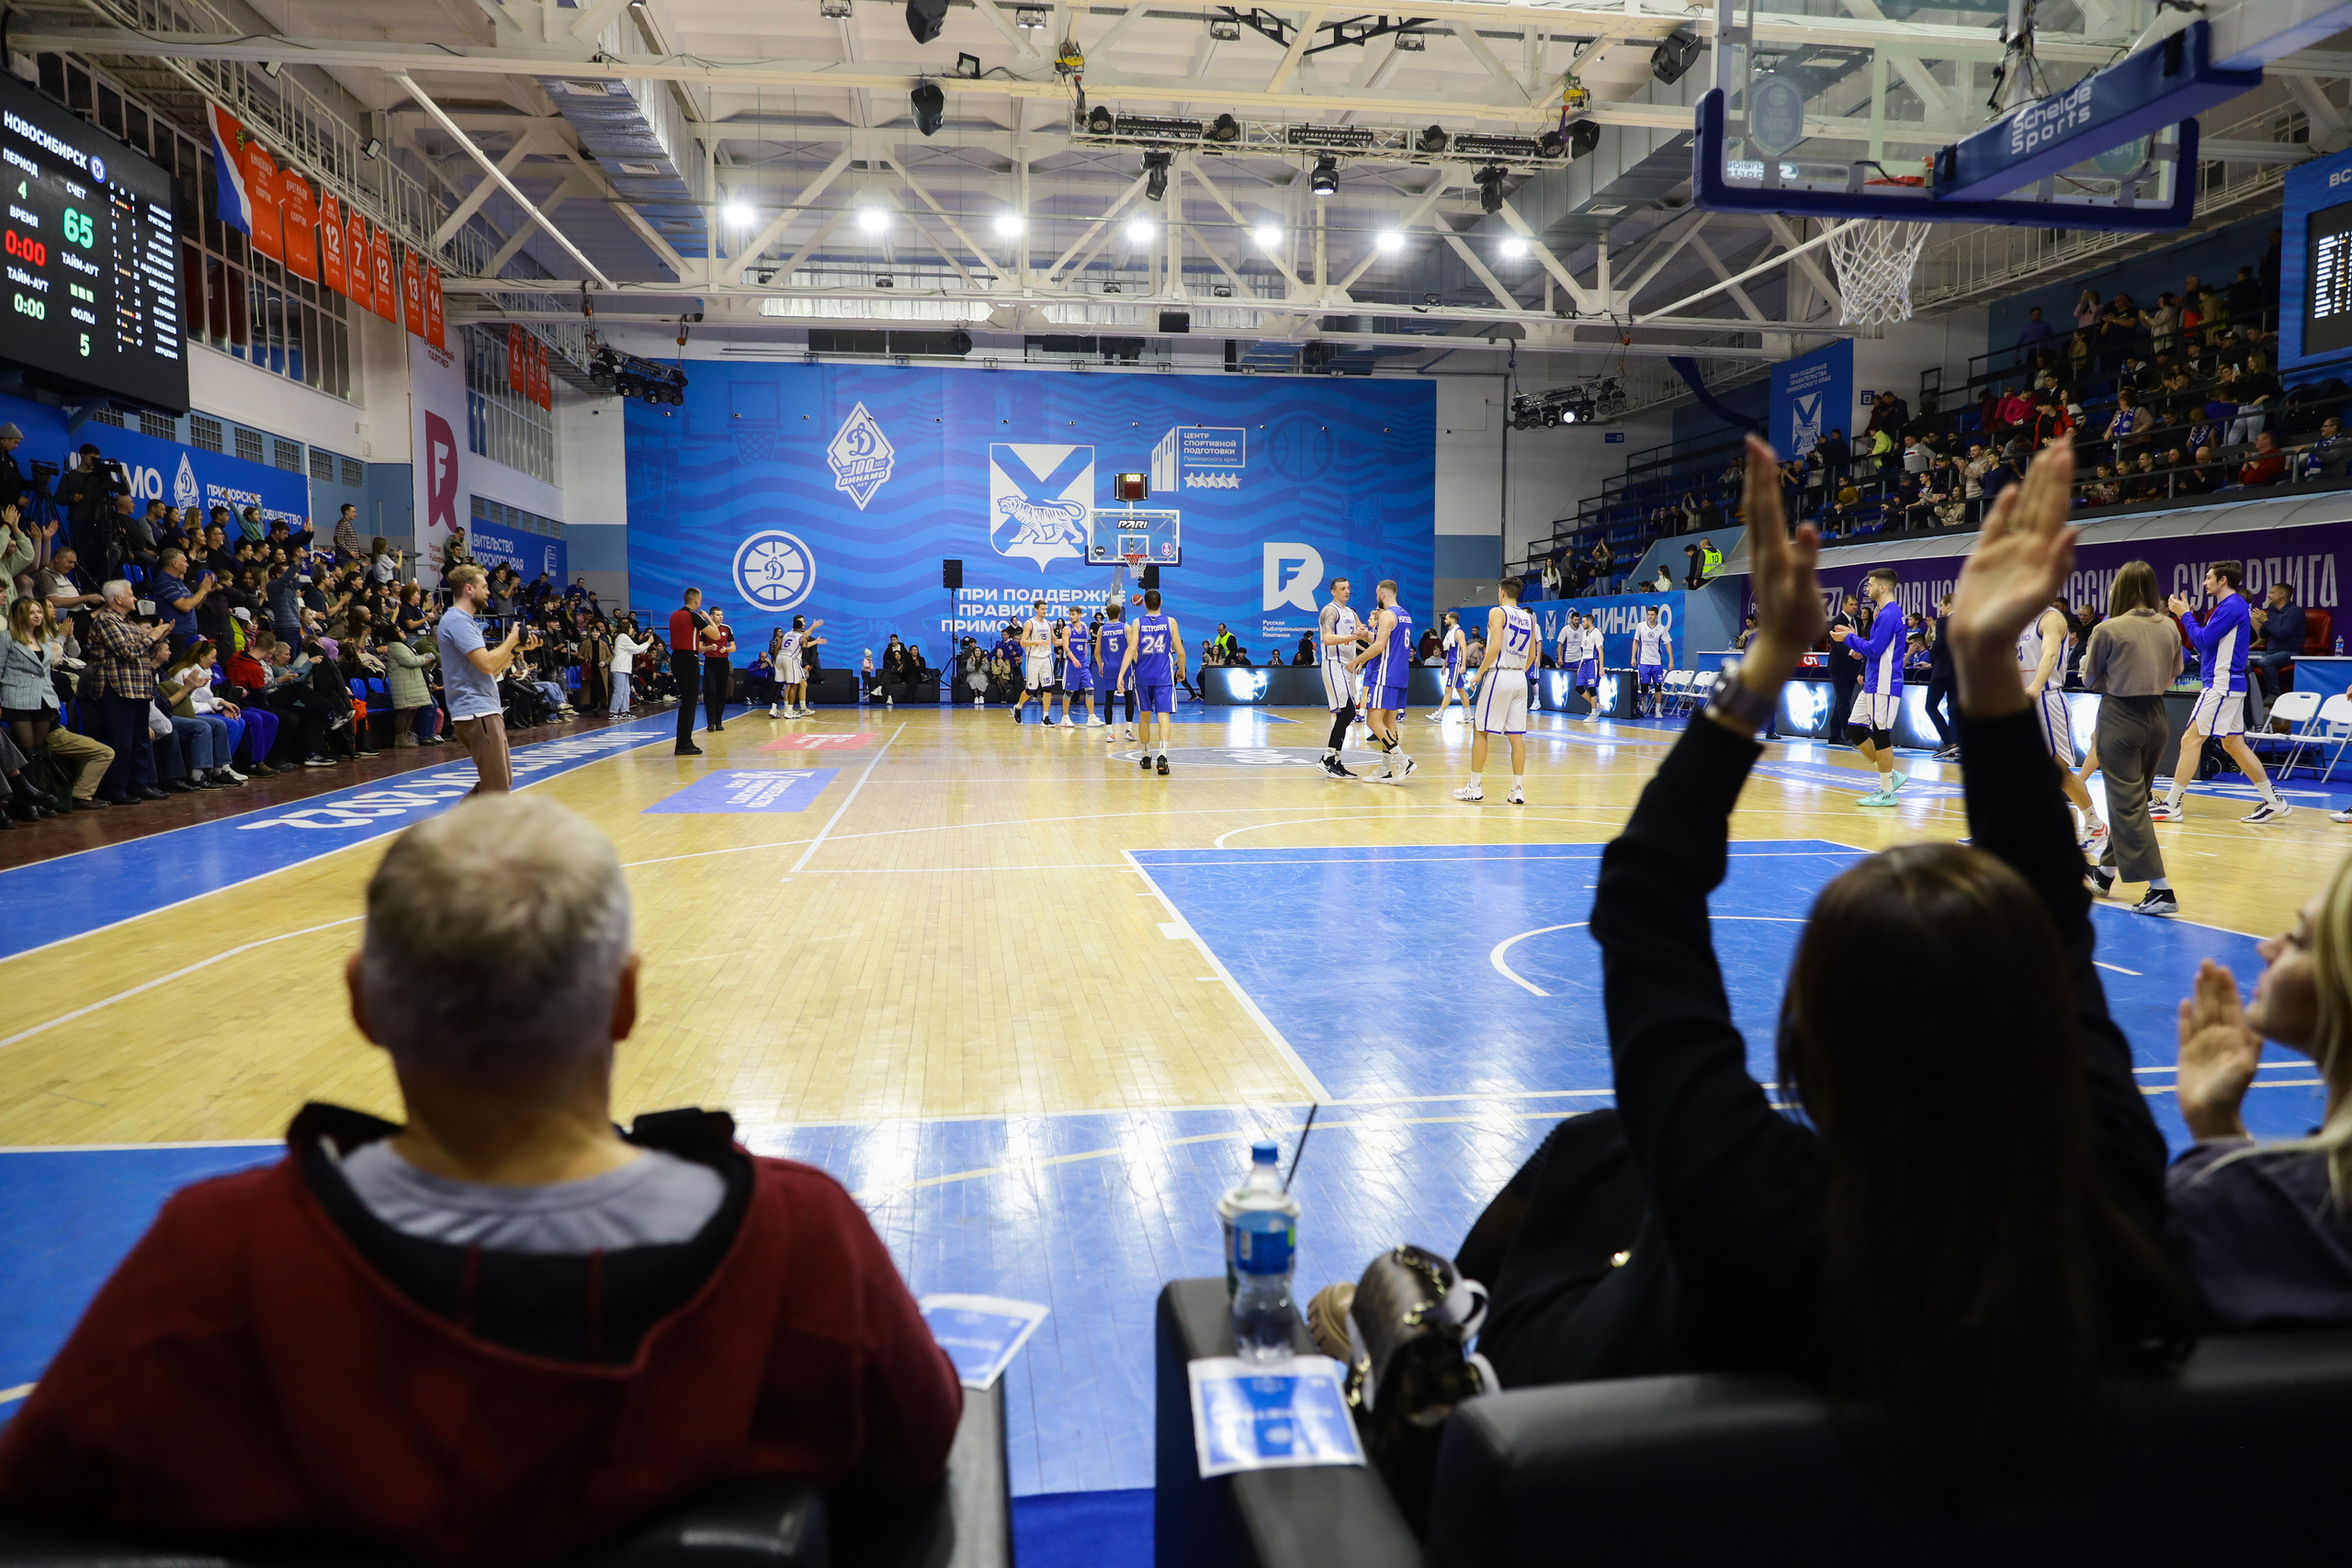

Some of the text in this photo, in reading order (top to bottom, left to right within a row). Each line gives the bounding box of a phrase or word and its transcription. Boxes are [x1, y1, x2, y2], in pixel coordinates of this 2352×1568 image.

[2012, 86, 2091, 136] Schelde
[4, 110, 87, 170] НОВОСИБИРСК
[2011, 106, 2091, 155] Sports
[3, 147, 39, 177] ПЕРИОД
[17, 181, 27, 199] 4
[66, 181, 86, 199] СЧЕТ
[9, 204, 39, 228] ВРЕМЯ
[63, 208, 94, 249] 65
[6, 230, 46, 266] 0:00
[324, 222, 340, 254] 12
[62, 251, 99, 277] ТАЙМ-АУТ
[354, 240, 363, 266] 7
[6, 265, 49, 292] ТАЙМ-АУТ
[376, 256, 390, 285] 12
[408, 277, 419, 301] 13
[429, 289, 440, 315] 14
[14, 292, 45, 321] 0:00
[71, 307, 96, 325] ФОЛЫ
[80, 333, 90, 356] 5
[514, 344, 519, 363] 6
[840, 471, 886, 486] ДИНАМО
[1117, 520, 1148, 529] PARI
[1712, 555, 1719, 563] 10
[959, 589, 993, 601] ПРИ
[2173, 553, 2338, 612] СУРЛИГА
[784, 638, 793, 648] 6
[1109, 637, 1119, 652] 5
[1141, 634, 1166, 655] 24
[1404, 627, 1411, 649] 6
[1509, 623, 1531, 652] 77
[236, 791, 464, 829] 2022
